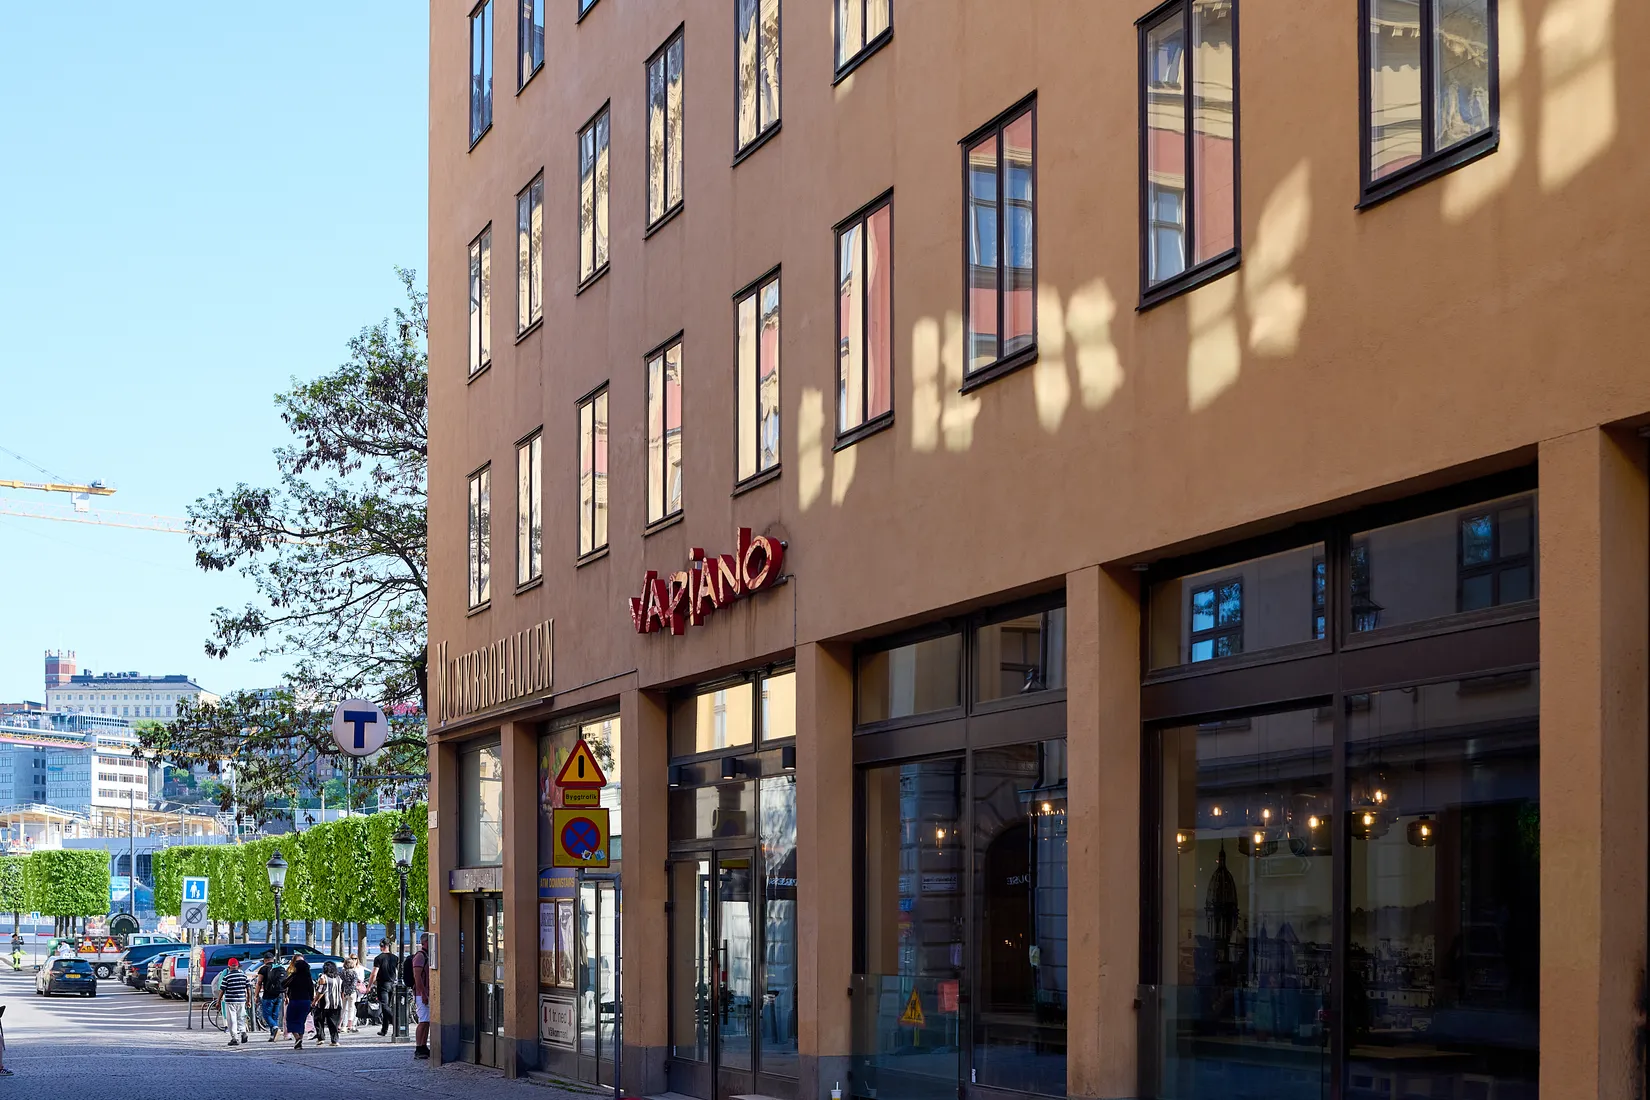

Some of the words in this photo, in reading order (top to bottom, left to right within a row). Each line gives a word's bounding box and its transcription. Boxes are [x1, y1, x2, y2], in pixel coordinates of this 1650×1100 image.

[628, 527, 784, 636] VAPIANO
[436, 618, 554, 723] MUNKBROHALLEN
[343, 710, 377, 749] T
[565, 793, 598, 801] Byggtrafik
